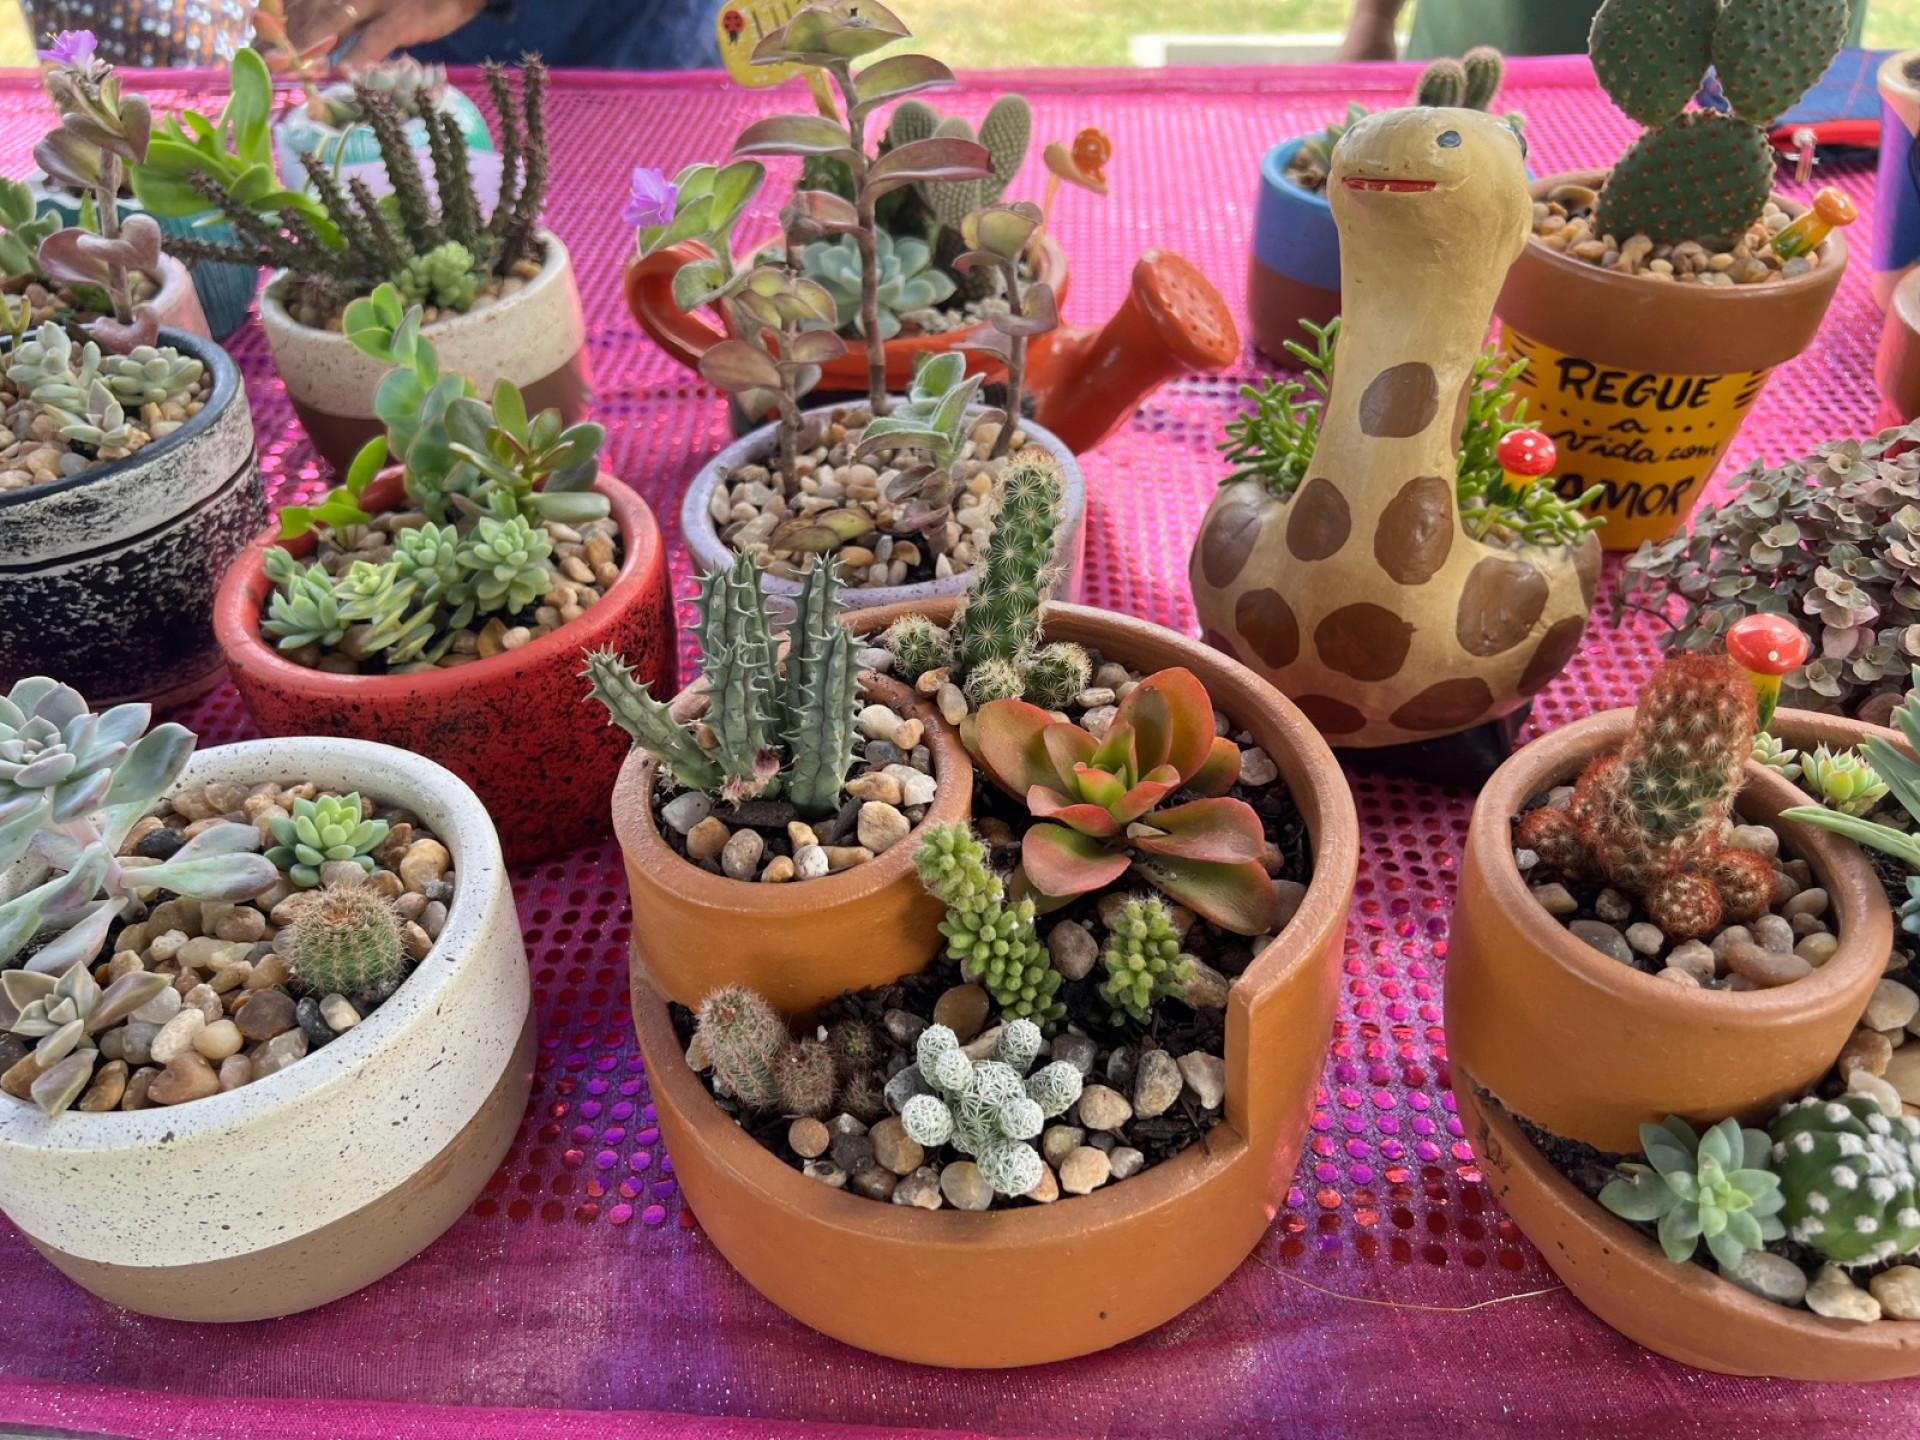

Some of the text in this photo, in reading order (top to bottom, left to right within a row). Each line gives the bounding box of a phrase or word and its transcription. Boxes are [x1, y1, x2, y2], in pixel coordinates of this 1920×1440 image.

[1555, 357, 1722, 411] REGUE
[1608, 419, 1653, 433] a
[1553, 474, 1695, 518] AMOR
